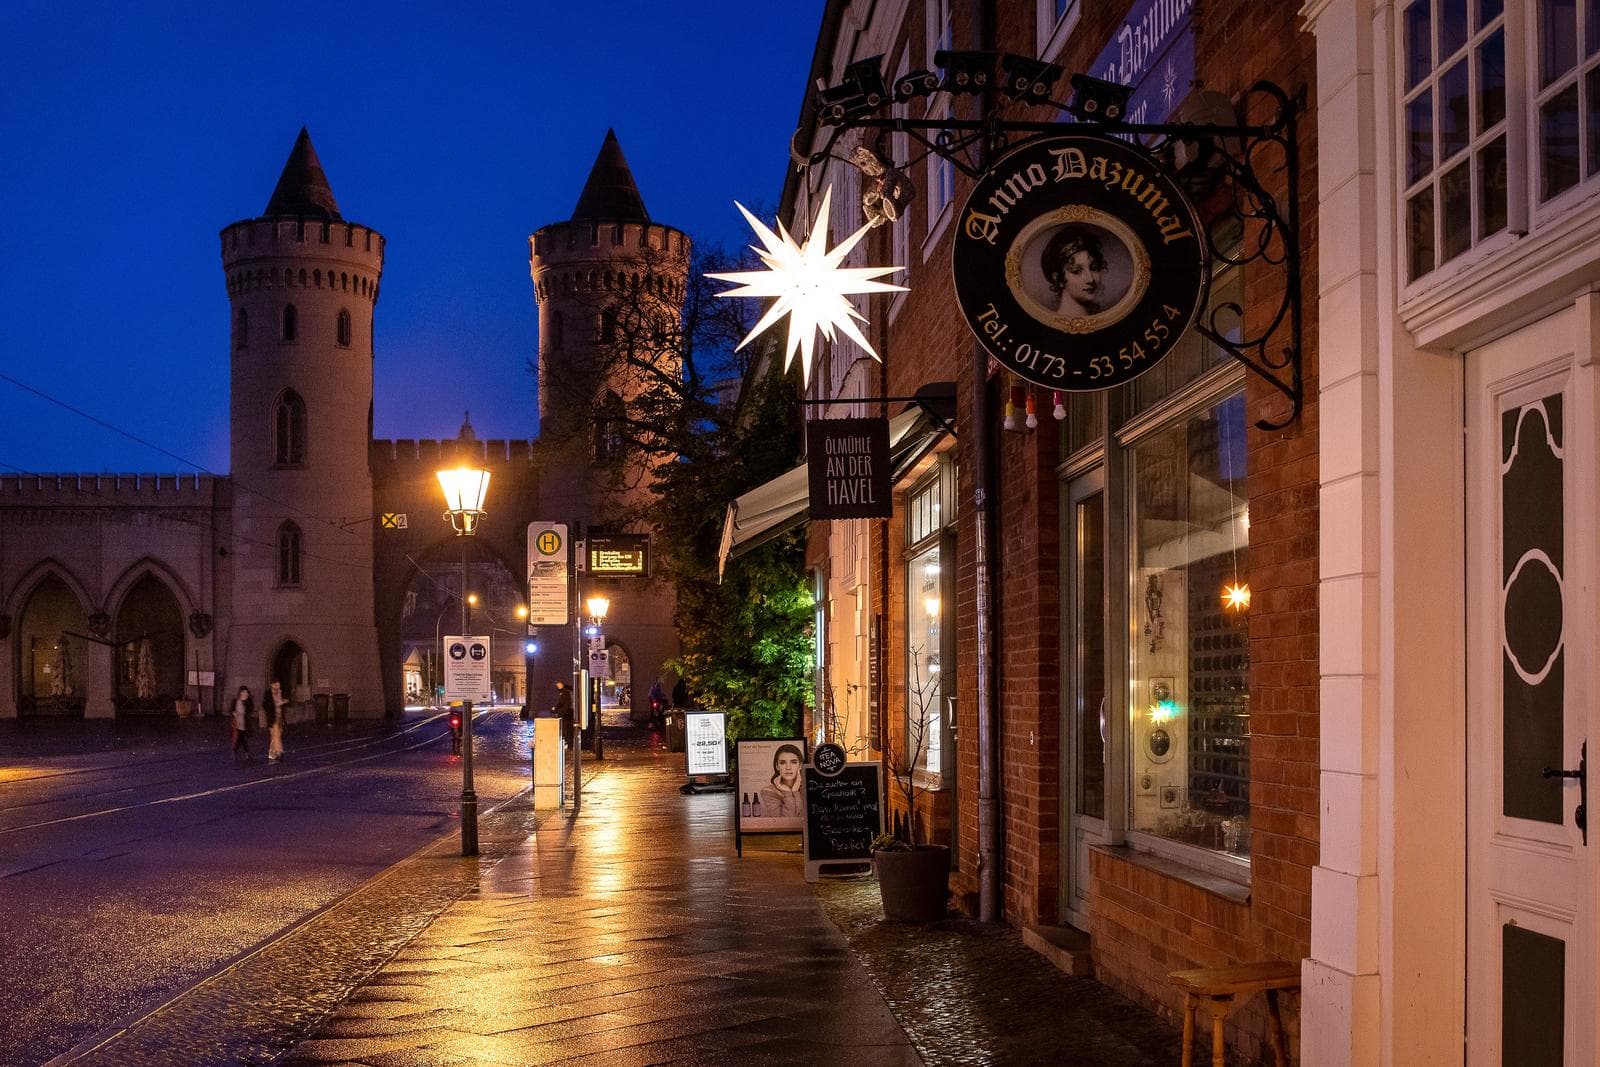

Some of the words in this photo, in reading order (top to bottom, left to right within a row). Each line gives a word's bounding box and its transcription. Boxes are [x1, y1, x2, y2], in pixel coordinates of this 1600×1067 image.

[965, 162, 1047, 246] Anno
[1047, 146, 1193, 247] Dazumal
[975, 302, 1014, 352] Tel.:
[1014, 342, 1066, 379] 0173
[1088, 355, 1115, 380] 53
[1118, 339, 1147, 371] 54
[1143, 318, 1171, 351] 55
[1163, 302, 1183, 321] 4
[825, 435, 872, 455] ÖLMÜHLE
[826, 456, 845, 478] AN
[849, 455, 873, 477] DER
[827, 478, 877, 505] HAVEL
[398, 516, 406, 527] 2
[543, 535, 555, 550] H
[819, 757, 842, 769] NOVA
